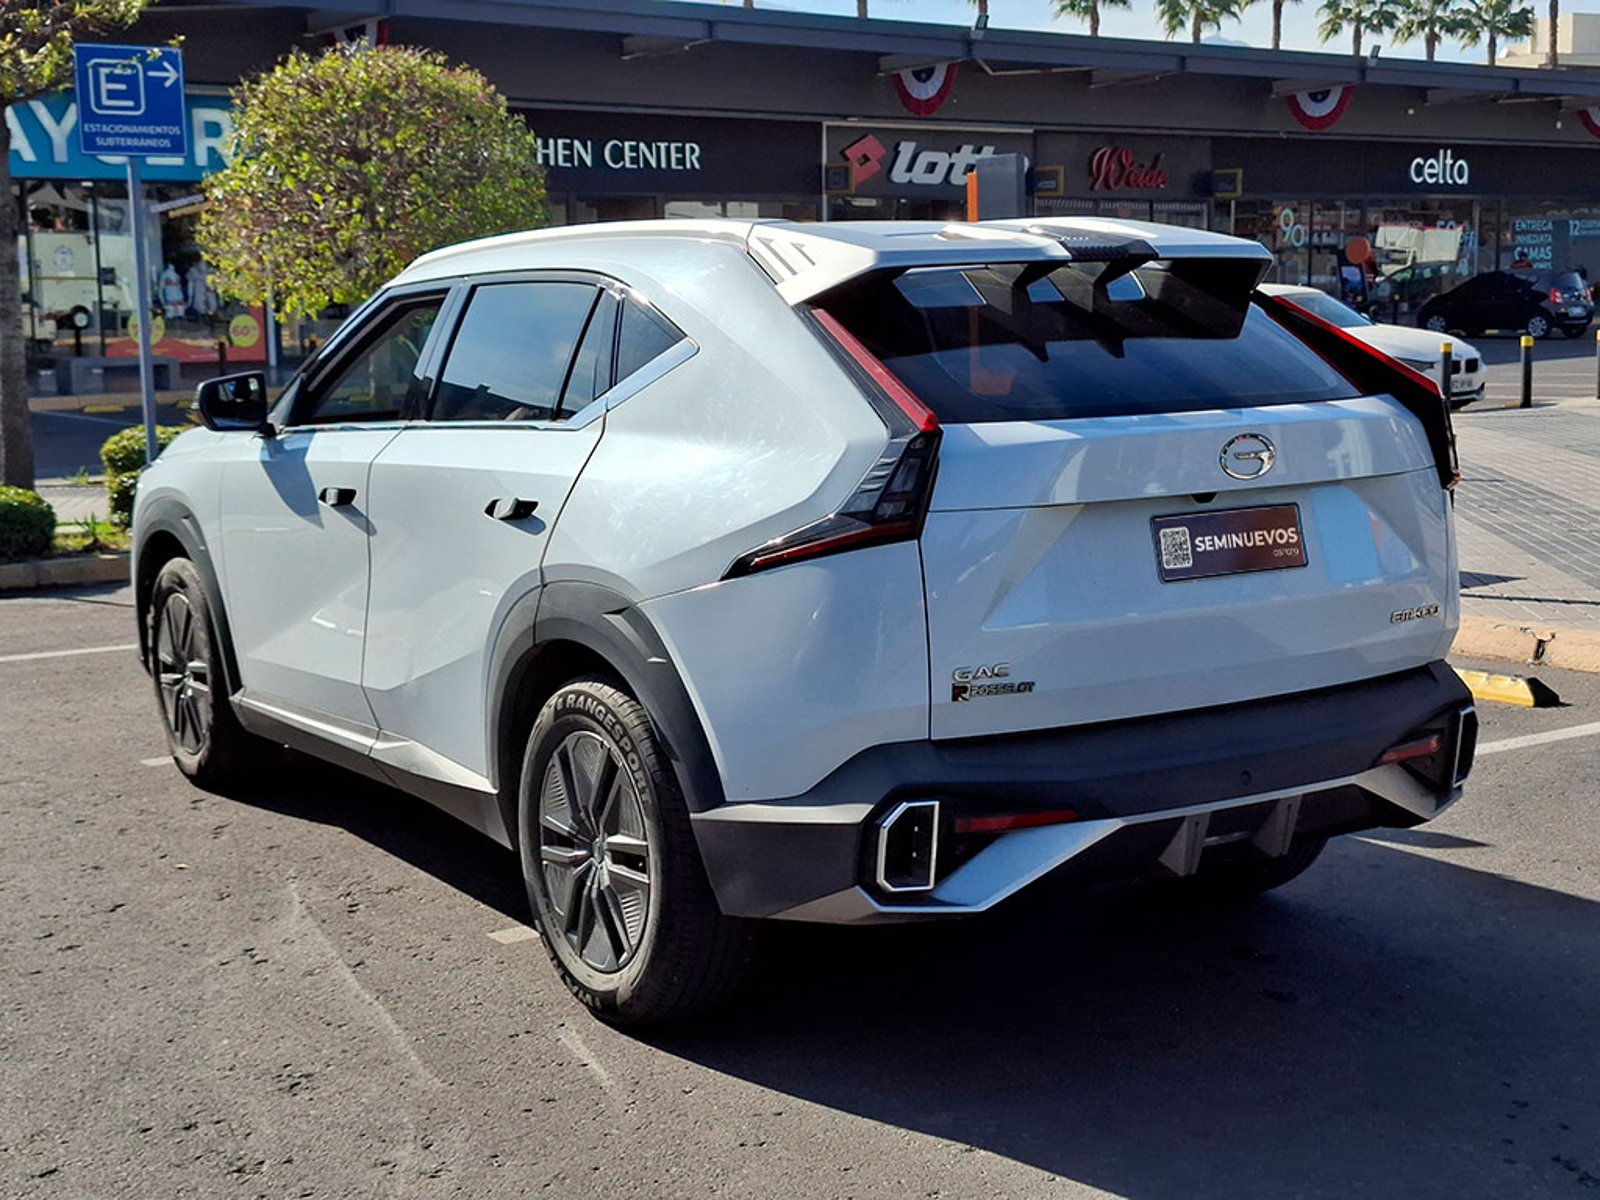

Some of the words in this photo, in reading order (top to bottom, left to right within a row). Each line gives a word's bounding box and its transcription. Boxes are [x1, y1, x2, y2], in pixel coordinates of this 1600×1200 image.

[100, 66, 136, 107] E
[83, 123, 181, 136] ESTACIONAMIENTOS
[603, 139, 701, 170] CENTER
[1410, 149, 1469, 185] celta
[1515, 219, 1553, 232] ENTREGA
[1194, 527, 1299, 552] SEMINUEVOS
[952, 662, 1009, 683] GAC
